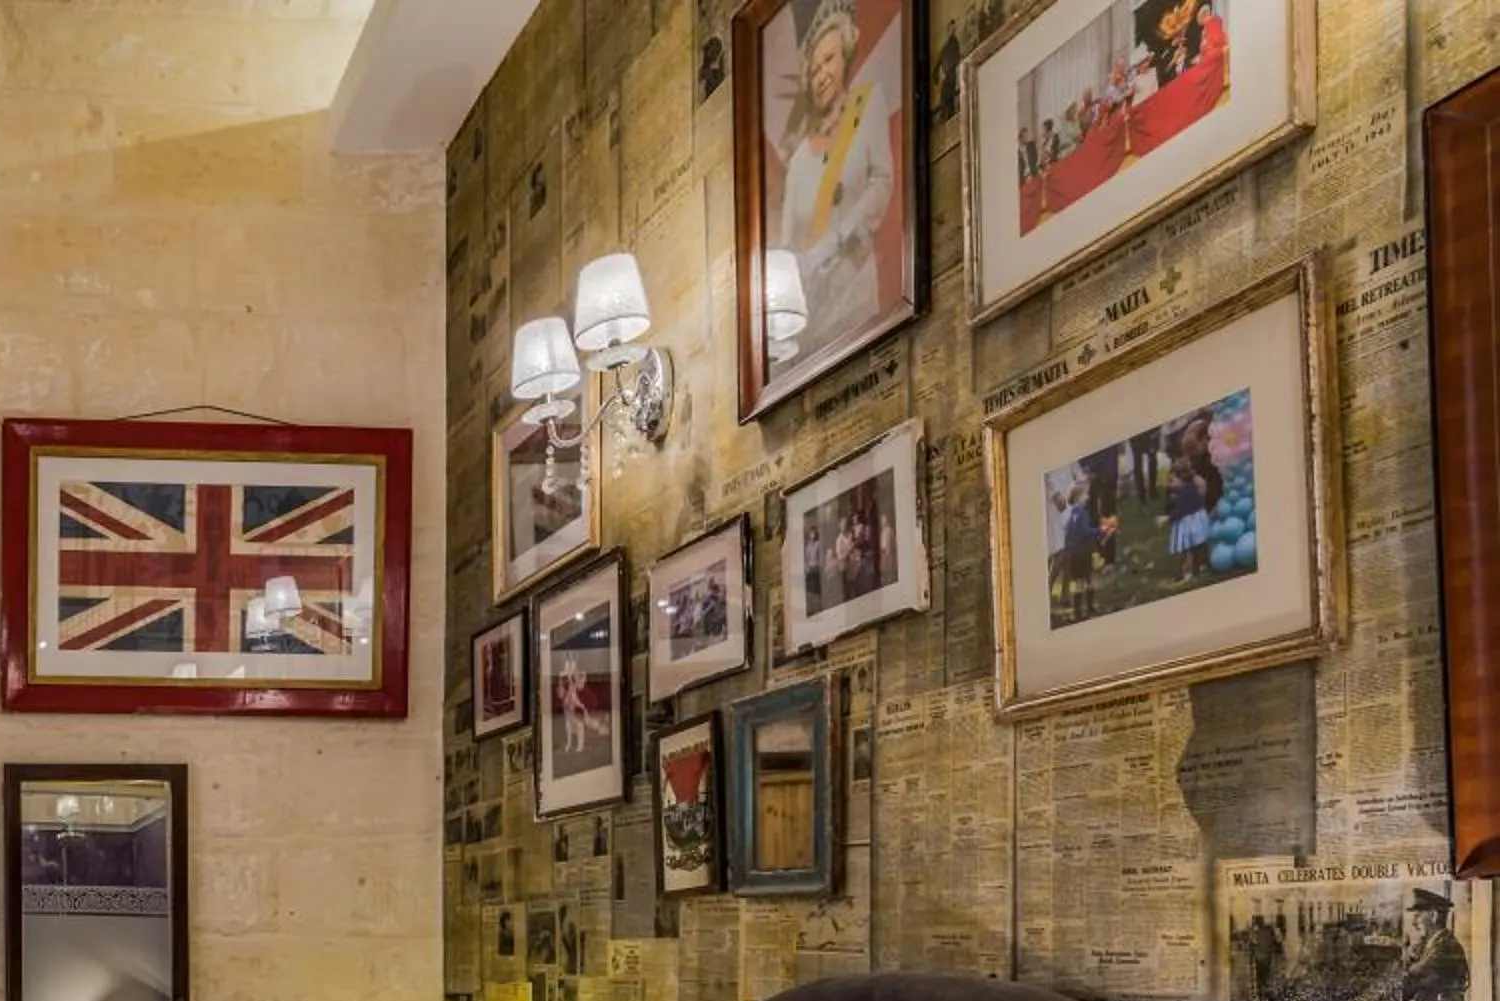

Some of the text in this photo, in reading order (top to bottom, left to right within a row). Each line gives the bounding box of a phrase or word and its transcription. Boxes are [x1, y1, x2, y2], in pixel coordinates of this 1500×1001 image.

[1368, 228, 1424, 275] TIME
[1104, 286, 1151, 321] MALTA
[1232, 871, 1269, 887] MALTA
[1277, 864, 1346, 884] CELEBRATES
[1351, 862, 1398, 880] DOUBLE
